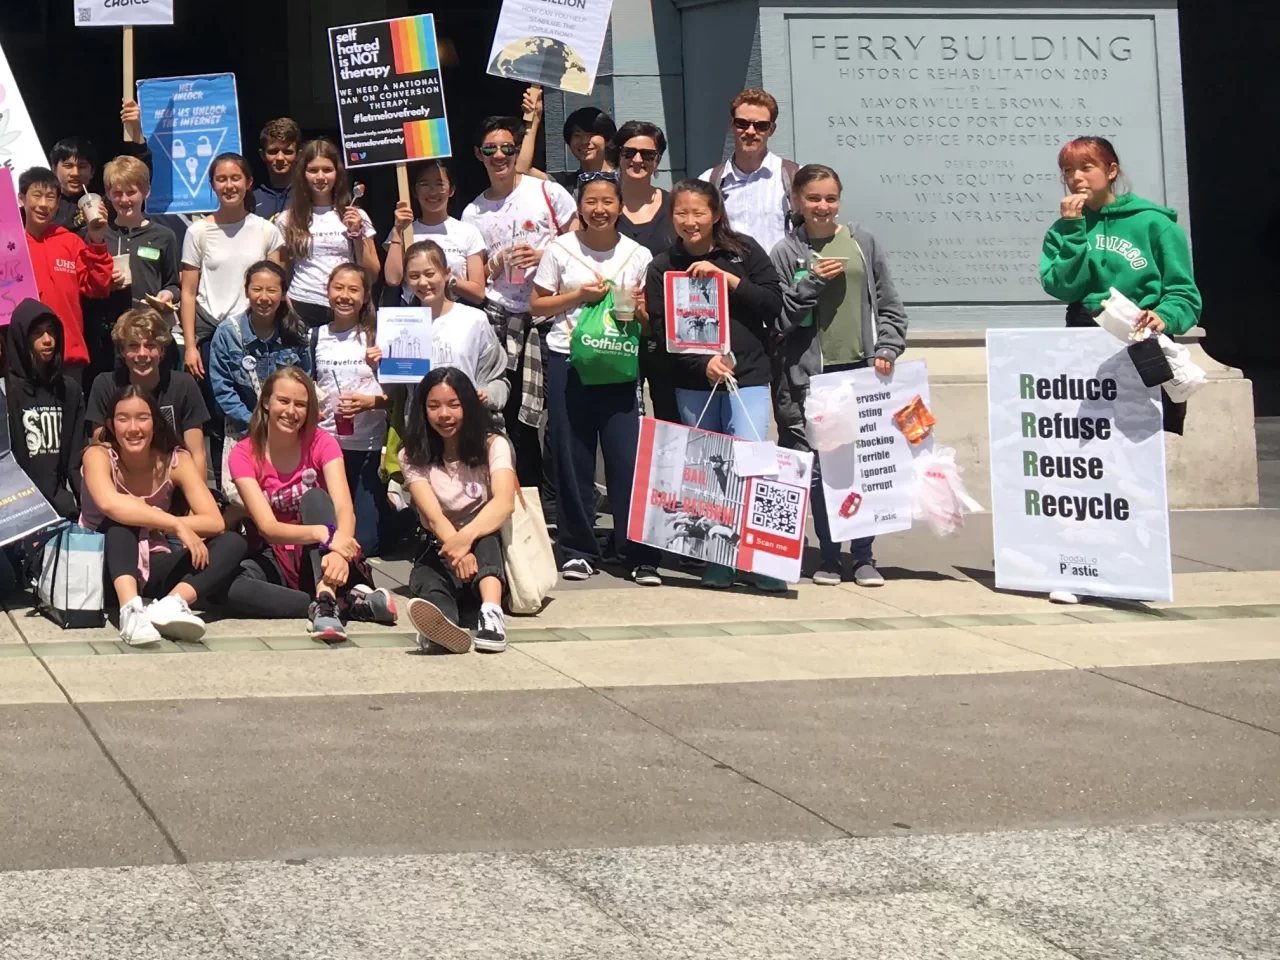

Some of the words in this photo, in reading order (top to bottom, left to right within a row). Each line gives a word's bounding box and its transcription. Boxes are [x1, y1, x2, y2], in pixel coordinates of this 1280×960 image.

[522, 5, 538, 14] HOW
[539, 8, 554, 18] CAN
[554, 11, 569, 20] YOU
[570, 14, 587, 23] HELP
[528, 16, 561, 28] STABILIZE
[563, 22, 576, 30] THE
[336, 28, 357, 43] self
[337, 38, 380, 56] hatred
[812, 35, 926, 61] FERRY
[940, 35, 1132, 61] BUILDING
[339, 55, 349, 68] is
[351, 50, 379, 66] NOT
[340, 65, 390, 80] therapy
[840, 68, 919, 80] HISTORIC
[927, 68, 1065, 80] REHABILITATION
[1073, 68, 1109, 81] 2003
[340, 89, 352, 97] WE
[356, 85, 379, 94] NEED
[393, 77, 439, 90] NATIONAL
[173, 90, 204, 101] UNLOCK
[340, 97, 359, 105] BAN
[362, 94, 375, 102] ON
[379, 86, 439, 100] CONVERSION
[369, 99, 413, 110] THERAPY.
[861, 97, 918, 109] MAYOR
[923, 97, 979, 109] WILLIE
[178, 107, 190, 117] US
[192, 104, 227, 116] UNLOCK
[353, 106, 431, 124] #letmelovefreely
[180, 115, 222, 127] INTERNET
[828, 116, 859, 128] SAN
[866, 116, 960, 128] FRANCISCO
[967, 116, 1008, 128] PORT
[1015, 116, 1124, 128] COMMISSION
[344, 136, 405, 149] @letmelovefreely
[837, 134, 897, 147] EQUITY
[904, 134, 960, 146] OFFICE
[967, 134, 1061, 146] PROPERTIES
[880, 174, 945, 185] WILSON
[956, 174, 1016, 187] EQUITY
[1023, 174, 1058, 185] OFFI
[915, 192, 980, 204] WILSON
[1096, 234, 1148, 270] DIEGO
[55, 258, 76, 269] UHS
[581, 333, 622, 351] Gothia
[1019, 374, 1117, 401] Reduce
[856, 391, 891, 404] ervasive
[860, 422, 877, 434] wful
[1021, 412, 1111, 440] Refuse
[855, 435, 895, 449] Shocking
[857, 450, 890, 463] Terrible
[860, 464, 896, 478] Ignorant
[1023, 450, 1103, 479] Reuse
[683, 466, 708, 486] BAIL
[18, 487, 36, 499] THAT
[861, 479, 893, 493] Corrupt
[651, 488, 677, 513] BAIL
[1024, 489, 1129, 521] Recycle
[756, 537, 774, 548] Scan
[776, 543, 788, 552] me
[1060, 562, 1098, 577] Pastic
